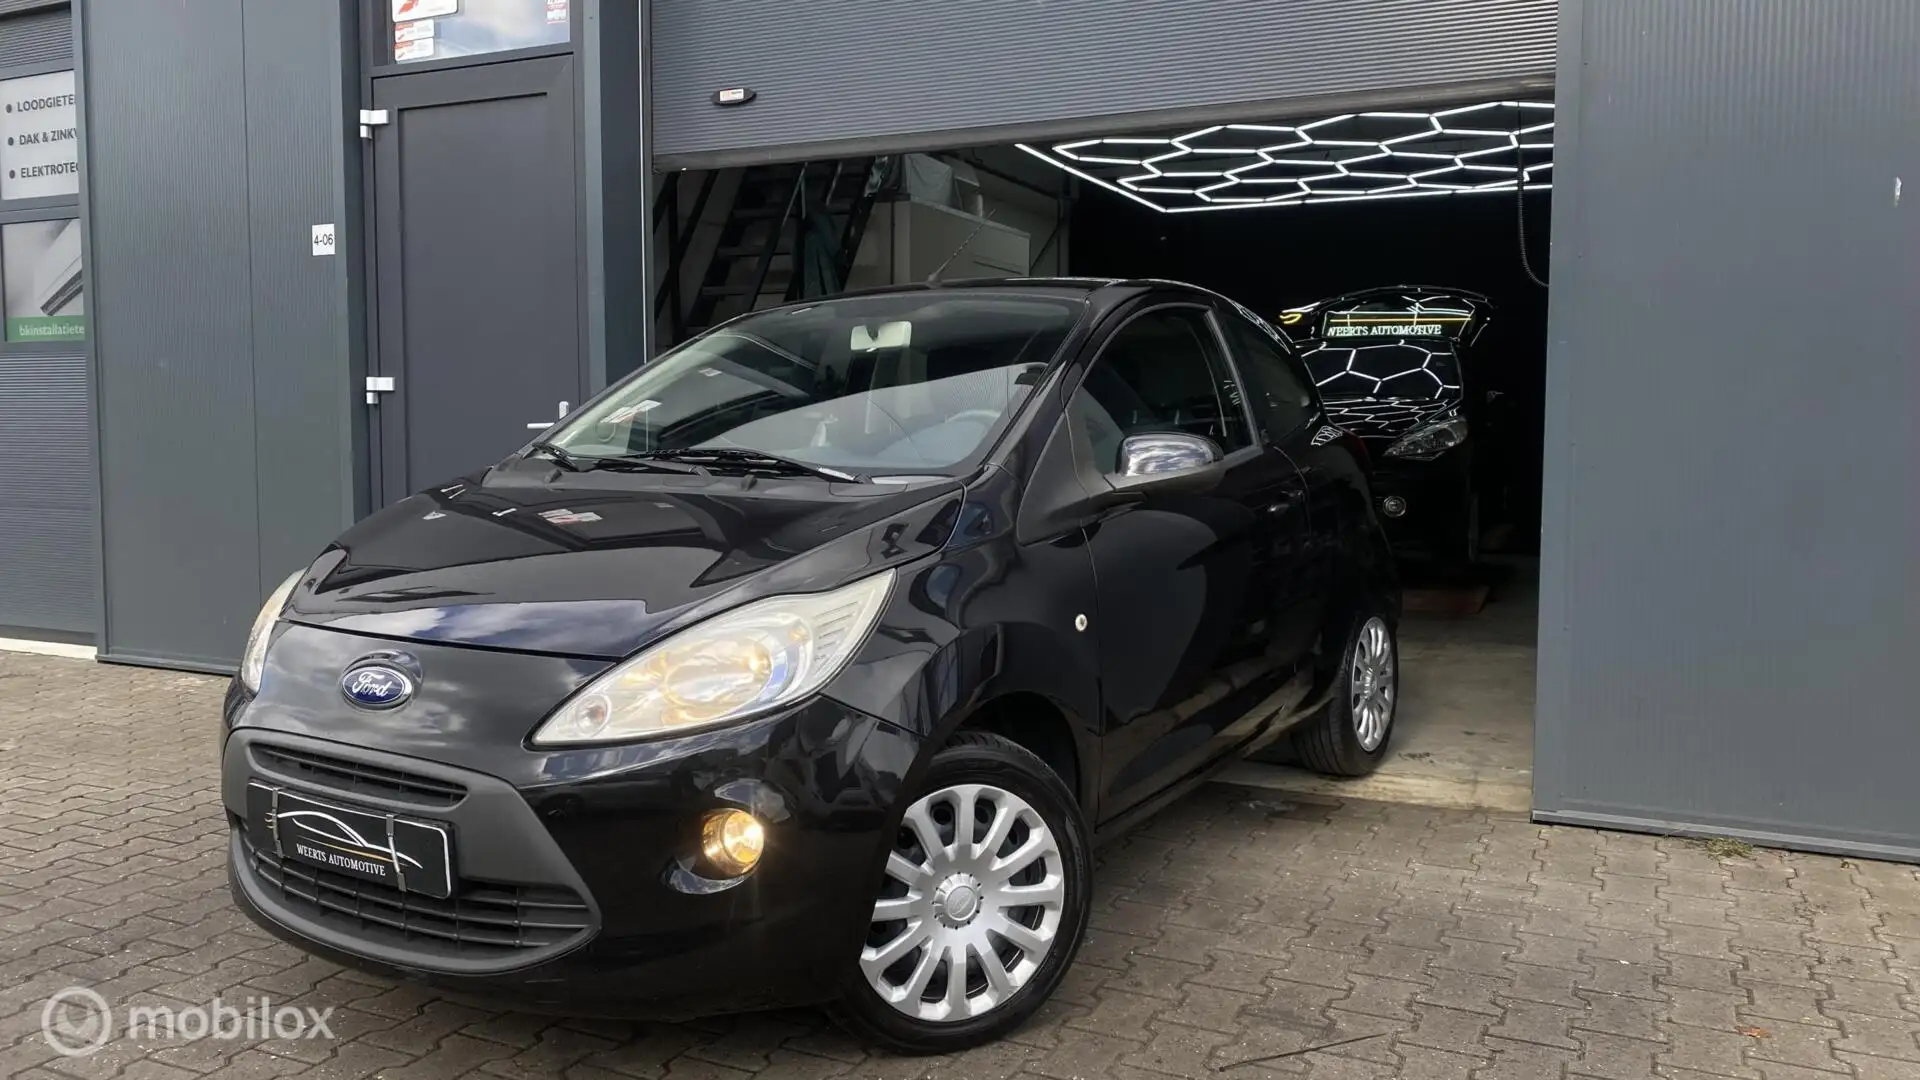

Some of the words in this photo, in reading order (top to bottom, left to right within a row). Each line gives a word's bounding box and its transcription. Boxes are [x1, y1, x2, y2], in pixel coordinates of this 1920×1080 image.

[17, 94, 76, 113] LOODGIETE
[19, 132, 40, 146] DAK
[42, 131, 49, 143] &
[313, 233, 334, 246] 4-06
[1370, 324, 1442, 336] AUTOMOTIVE
[352, 671, 392, 697] Ford
[296, 843, 327, 862] WEERTS
[328, 853, 386, 876] AUTOMOTIVE
